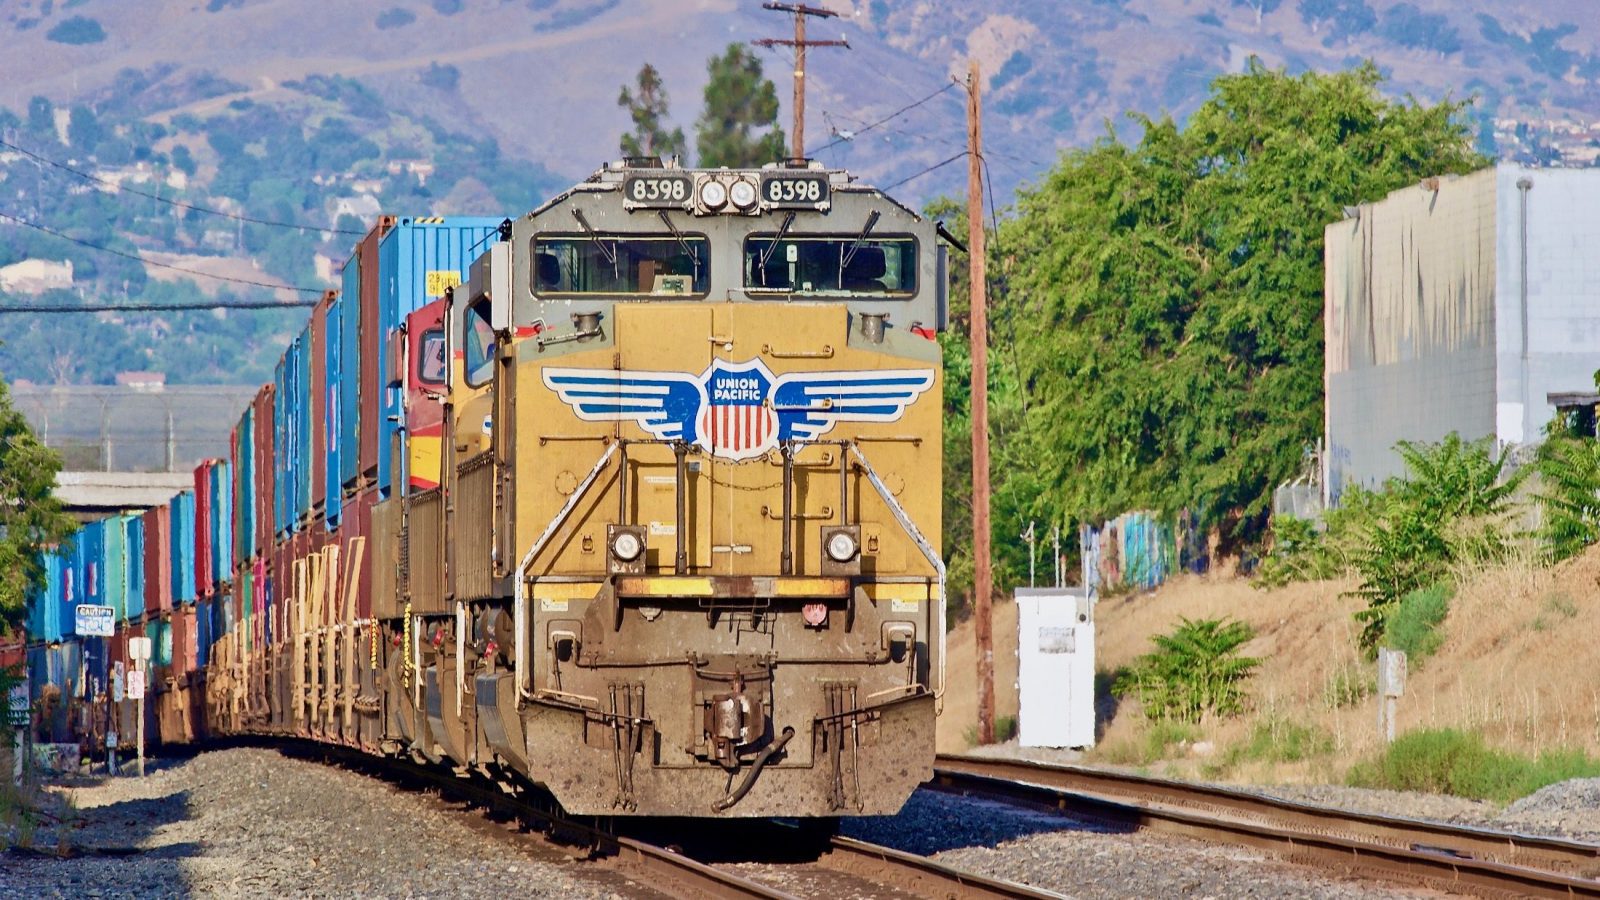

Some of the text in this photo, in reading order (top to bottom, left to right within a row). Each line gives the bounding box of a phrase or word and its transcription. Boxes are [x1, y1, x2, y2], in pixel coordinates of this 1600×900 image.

[633, 179, 685, 200] 8398
[769, 180, 820, 201] 8398
[716, 378, 759, 389] UNION
[714, 389, 760, 400] PACIFIC
[79, 607, 112, 617] CAUTION
